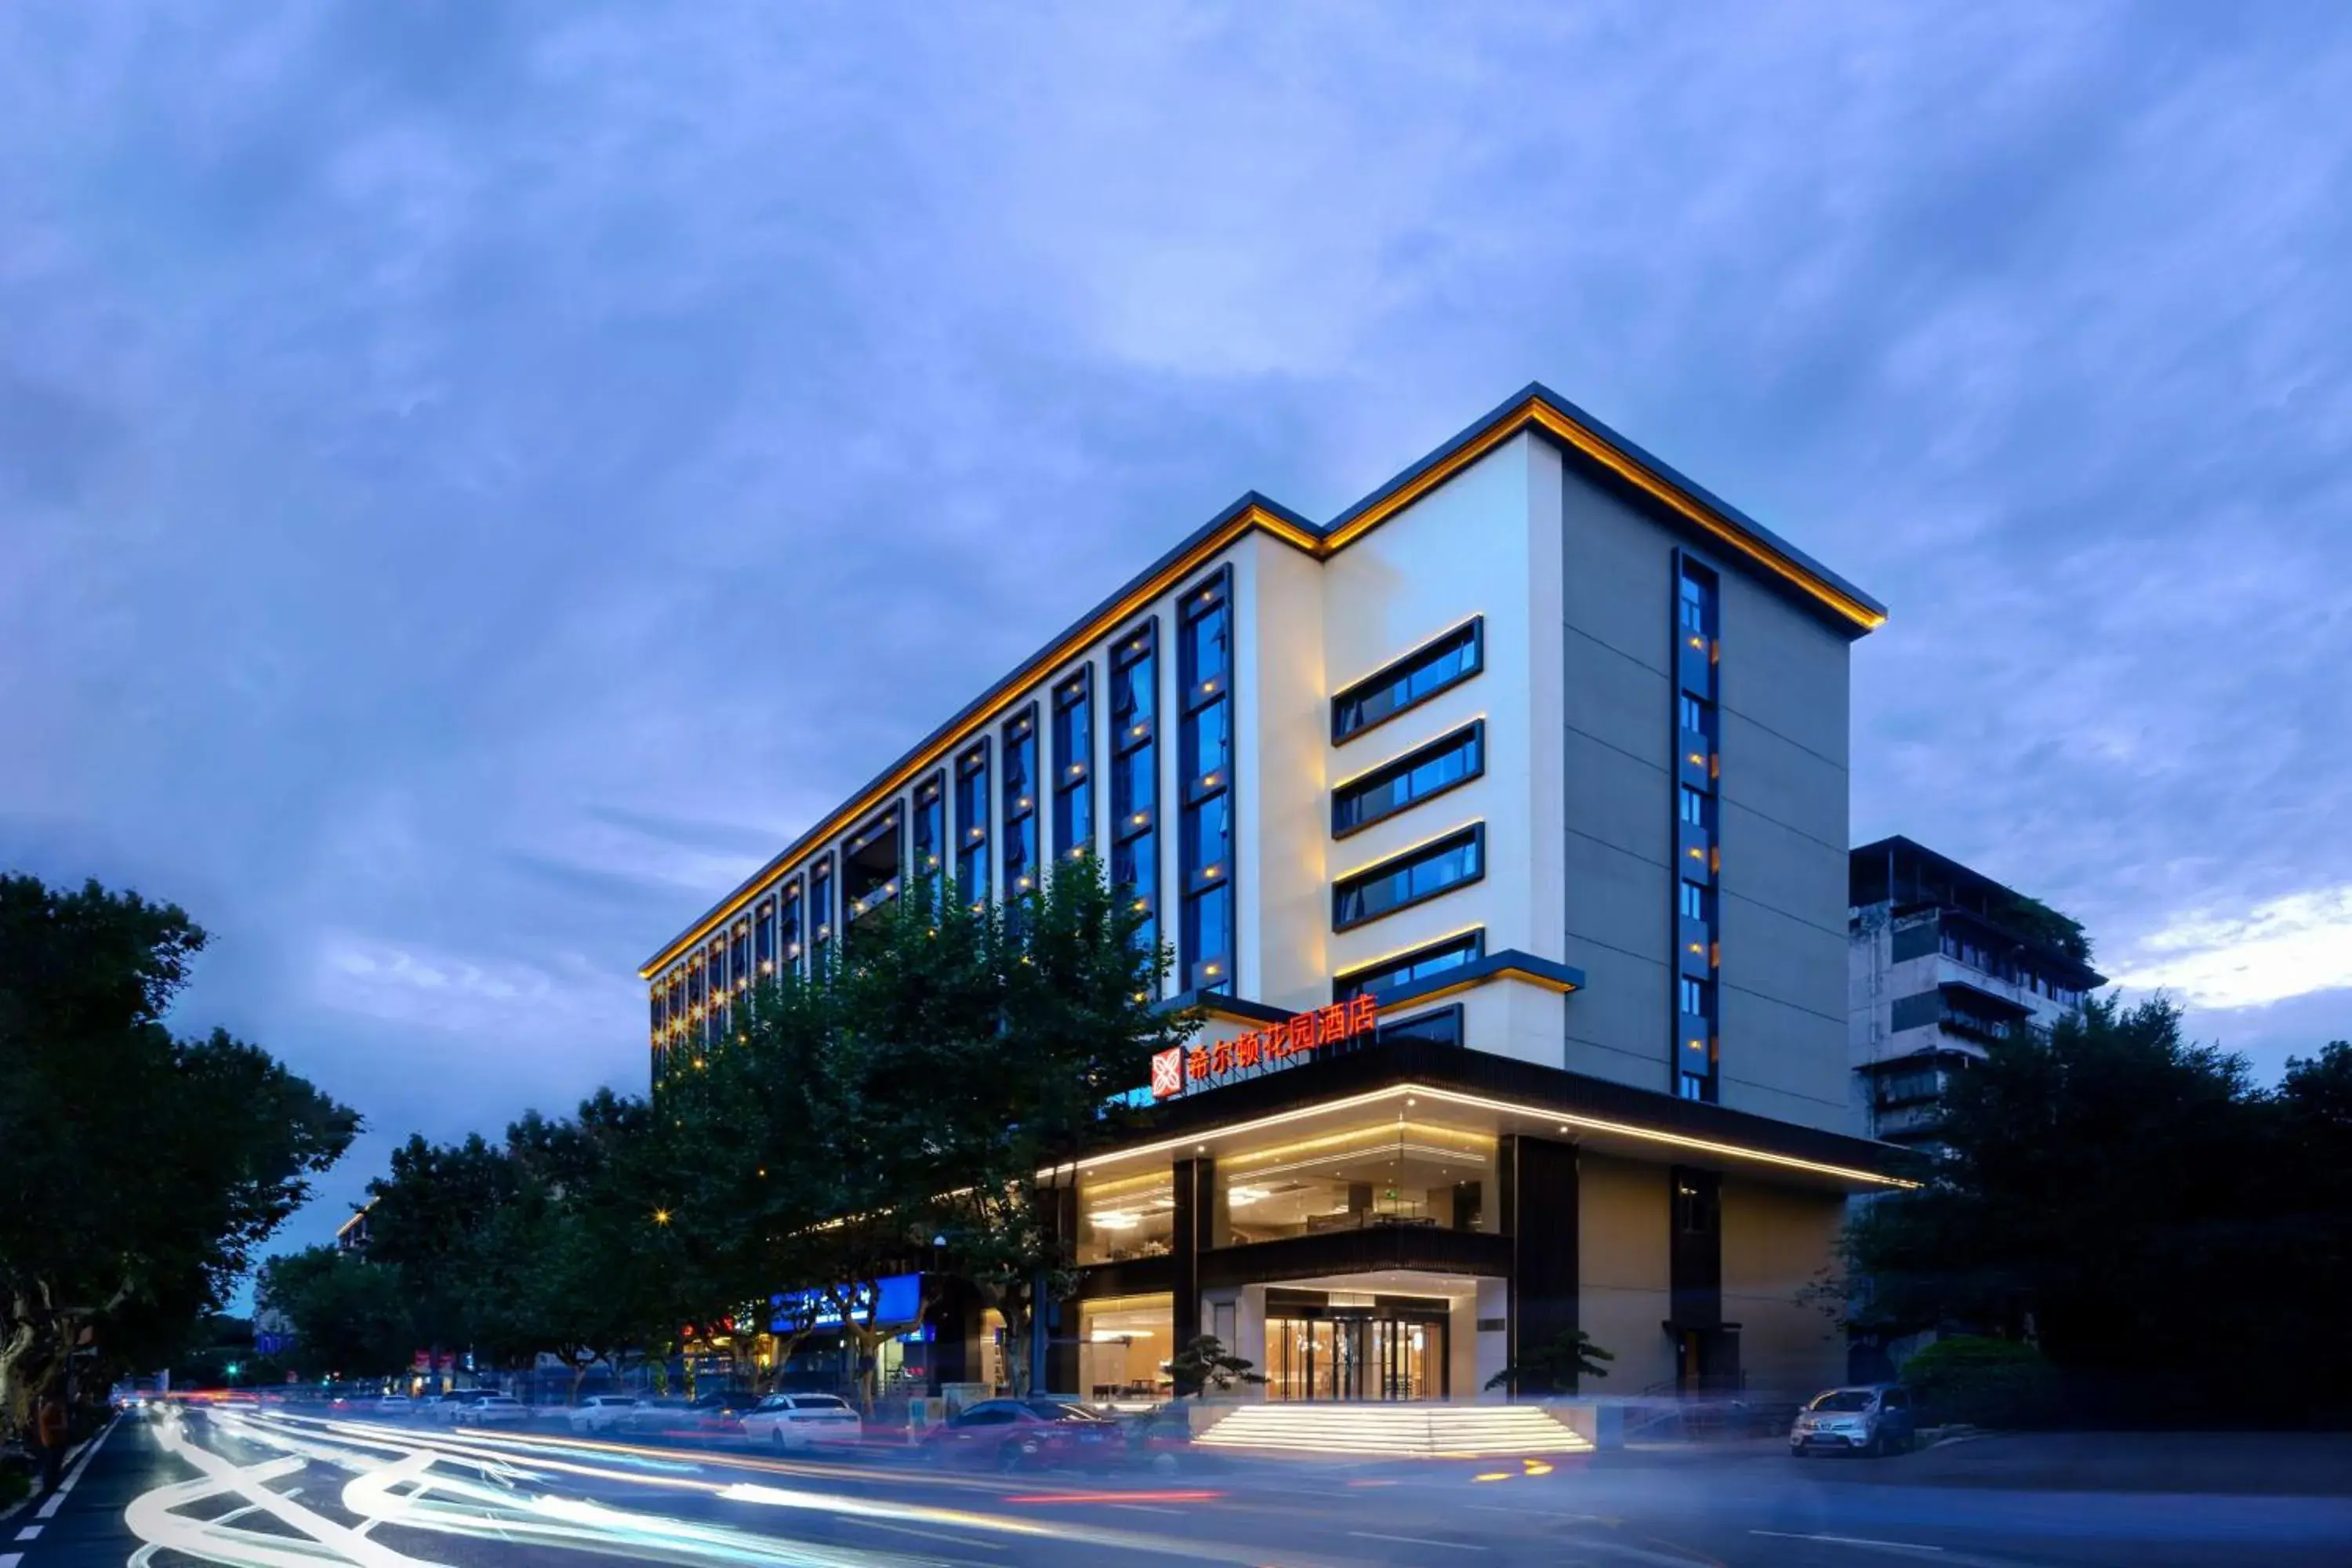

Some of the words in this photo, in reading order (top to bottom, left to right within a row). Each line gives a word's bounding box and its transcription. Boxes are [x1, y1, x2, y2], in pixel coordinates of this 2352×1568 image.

[1188, 993, 1377, 1080] 希尔顿花园酒店
